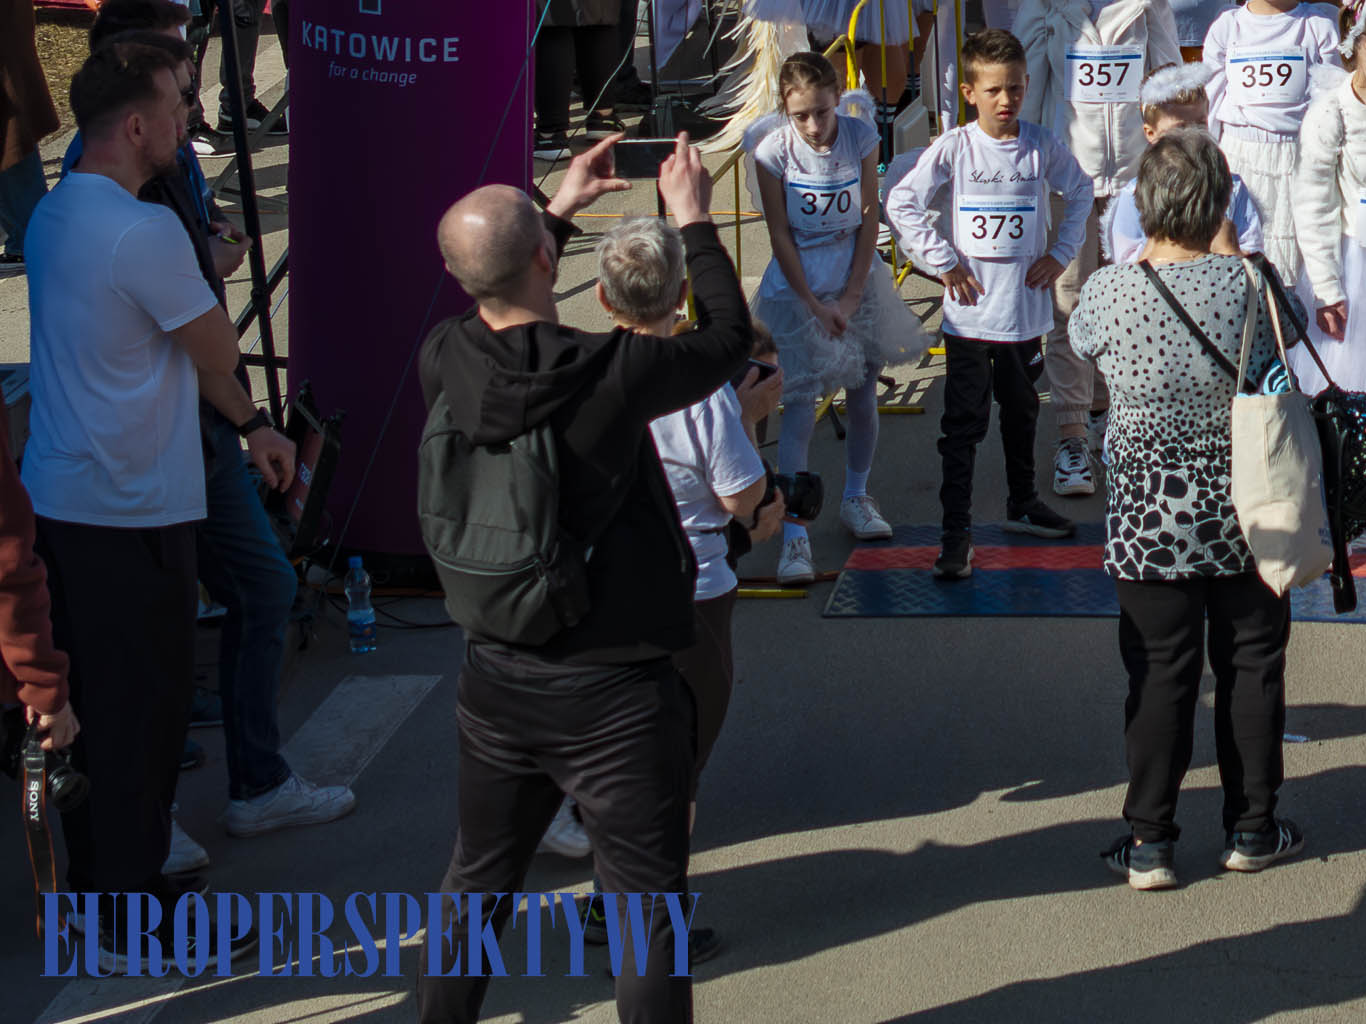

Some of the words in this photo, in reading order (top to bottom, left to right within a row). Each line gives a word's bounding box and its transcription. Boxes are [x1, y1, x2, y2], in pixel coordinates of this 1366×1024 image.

[302, 20, 459, 62] KATOWICE
[329, 61, 346, 79] for
[350, 67, 358, 79] a
[362, 68, 417, 87] change
[1078, 63, 1130, 87] 357
[1241, 63, 1292, 88] 359
[800, 190, 851, 216] 370
[971, 214, 1024, 240] 373
[29, 780, 40, 823] SONY
